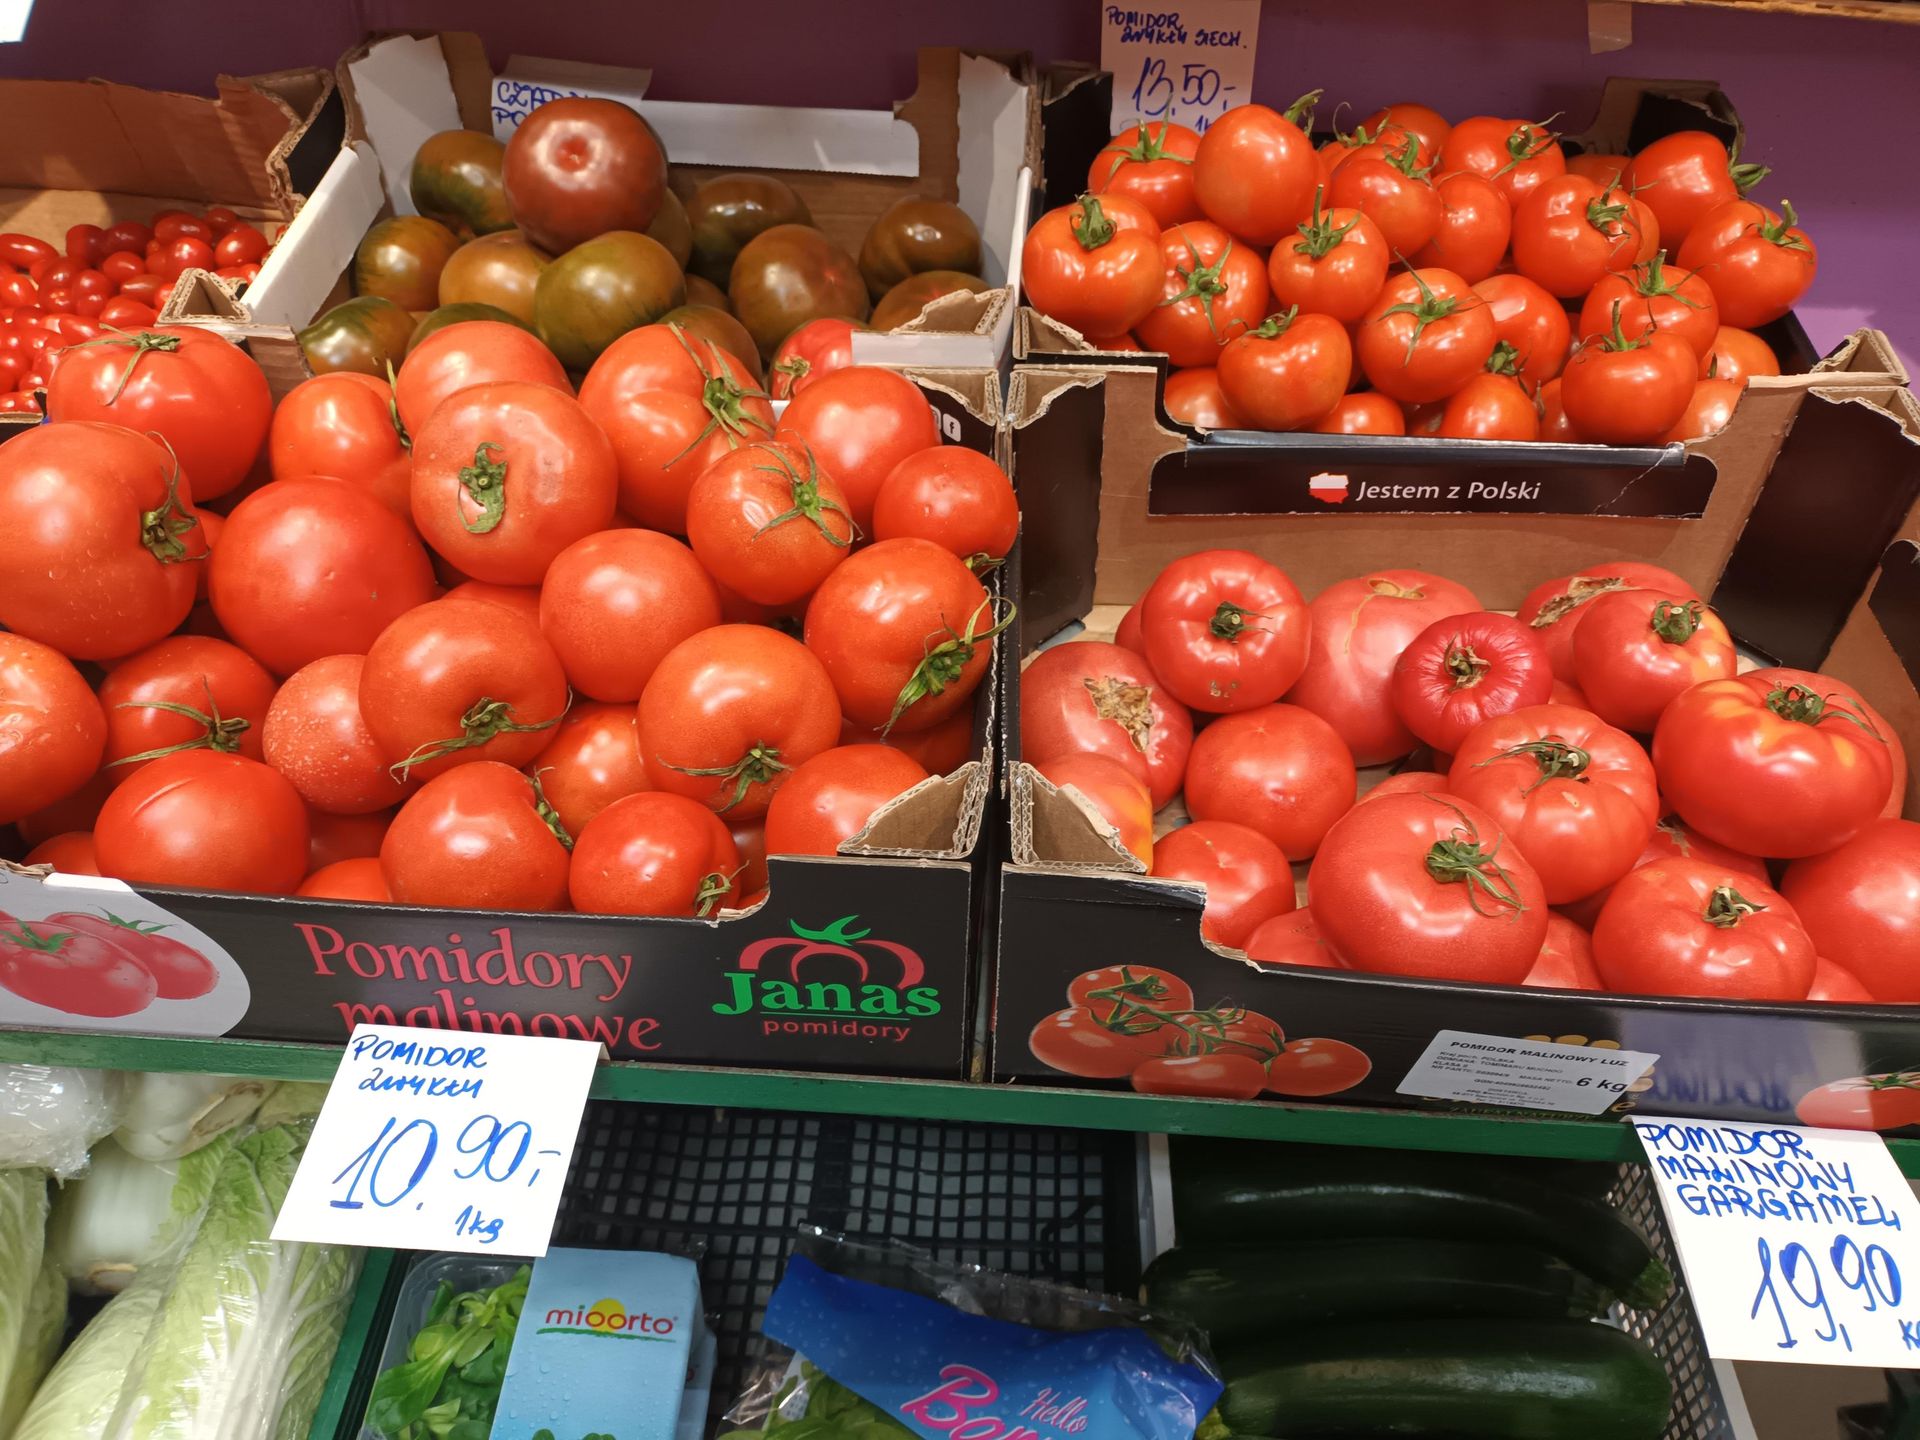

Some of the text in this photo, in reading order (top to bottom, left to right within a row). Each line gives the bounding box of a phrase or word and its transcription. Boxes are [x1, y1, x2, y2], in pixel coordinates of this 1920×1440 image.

[1105, 6, 1184, 31] POMIDOR
[1356, 481, 1541, 501] Jestem z Polski
[293, 922, 632, 1001] Pomidory
[712, 972, 941, 1016] Janas
[763, 1020, 911, 1041] pomidory
[352, 1034, 487, 1068] POMIDOR
[1450, 1041, 1629, 1067] POMIDOR MALINOWY LUZ
[1576, 1076, 1593, 1088] 6
[1597, 1078, 1628, 1093] kg
[1634, 1123, 1814, 1161] POMIDOR
[1676, 1183, 1901, 1231] GARGAMEL
[545, 1304, 674, 1335] mioorto
[1019, 1387, 1088, 1433] Hello
